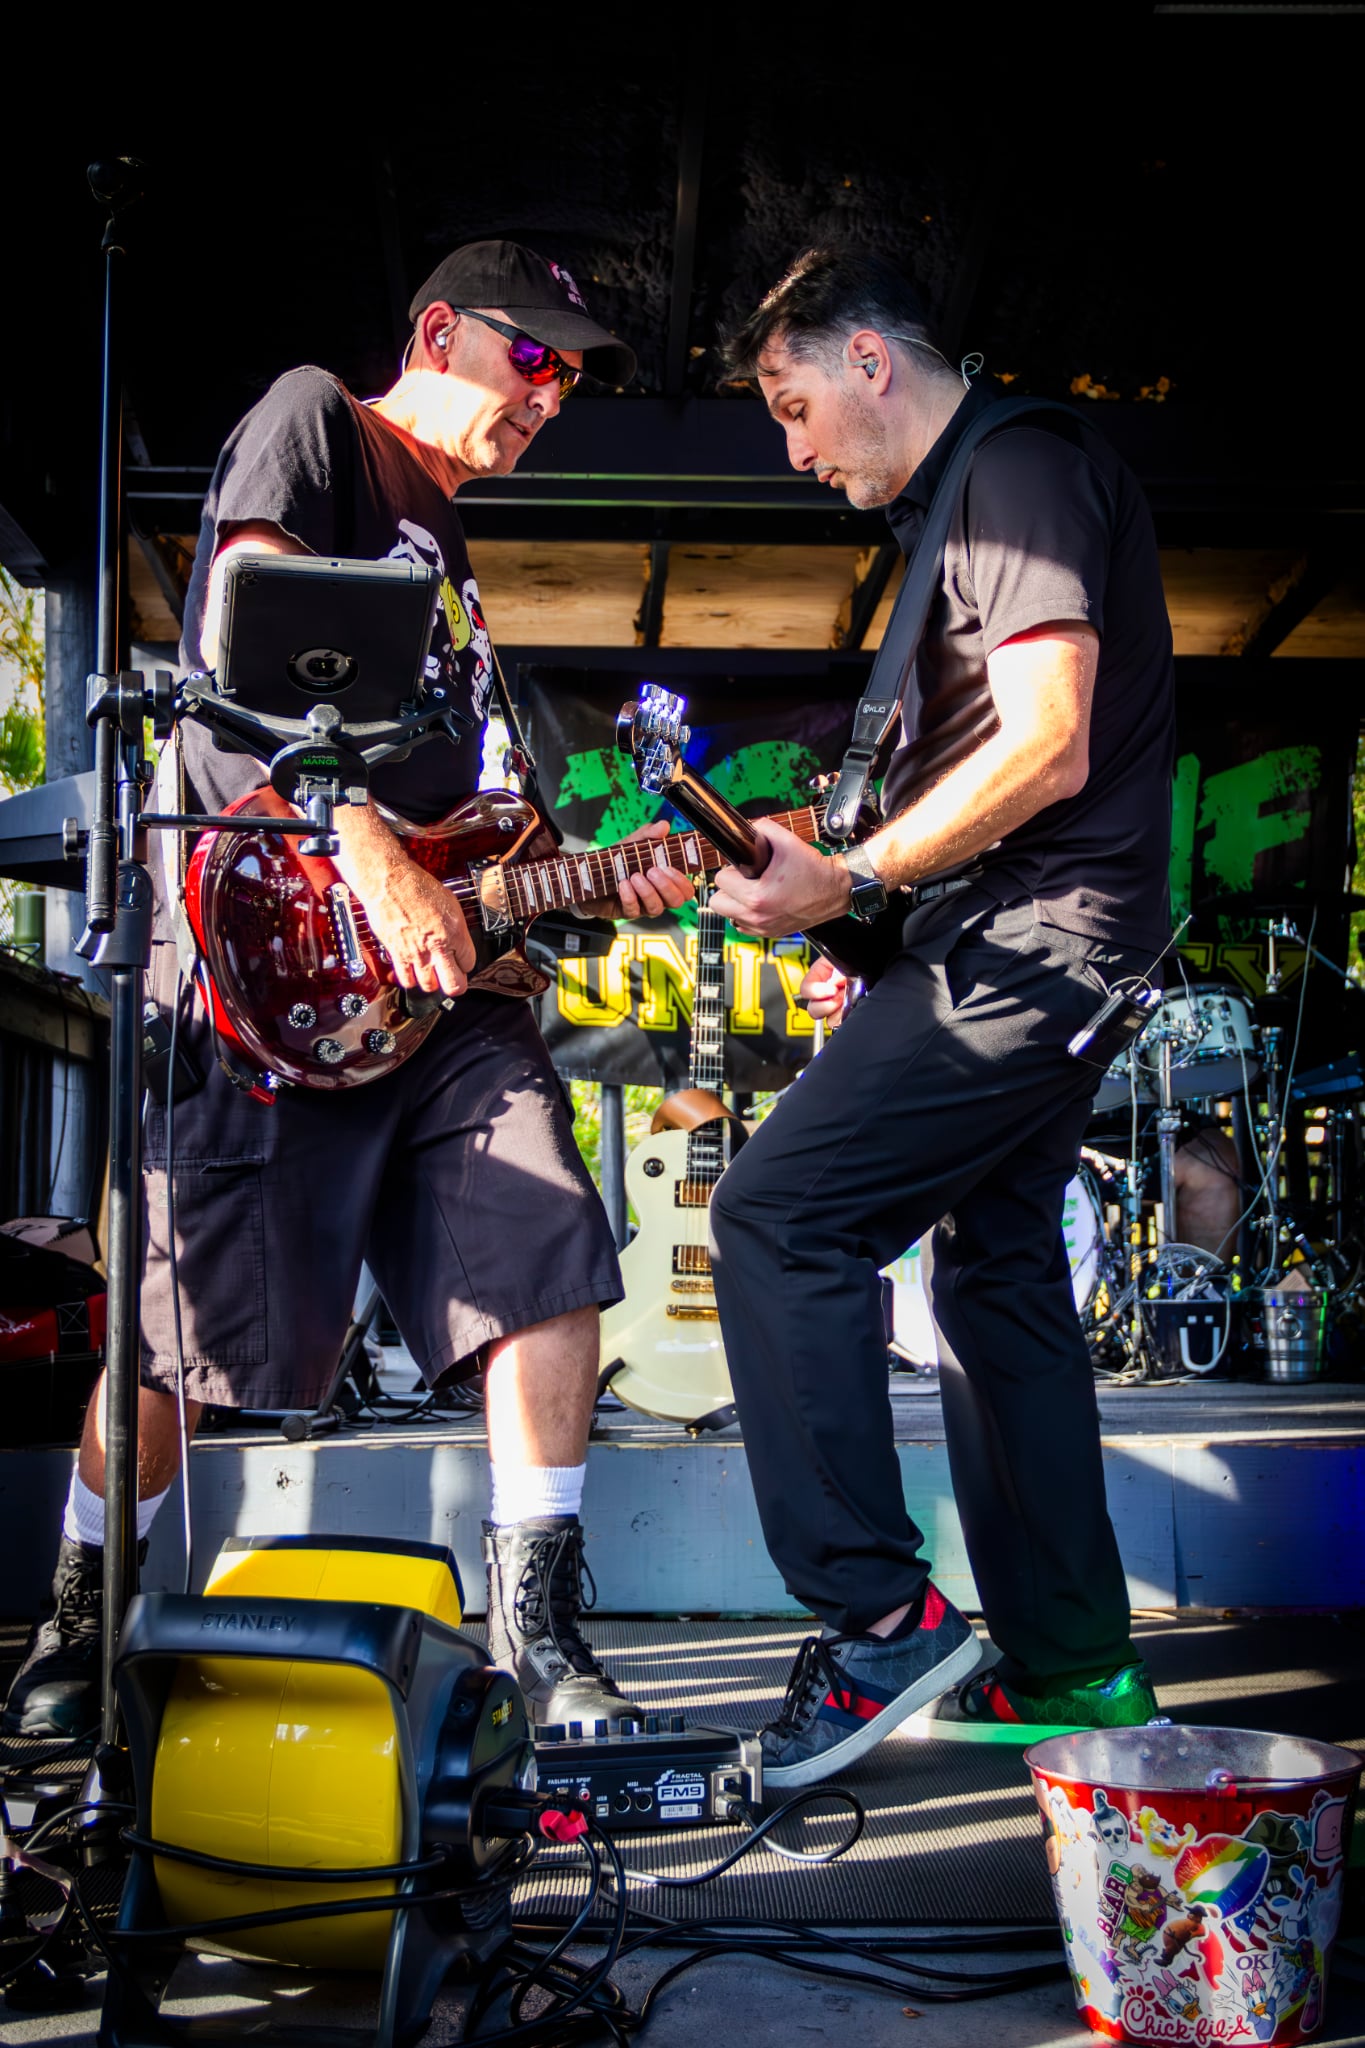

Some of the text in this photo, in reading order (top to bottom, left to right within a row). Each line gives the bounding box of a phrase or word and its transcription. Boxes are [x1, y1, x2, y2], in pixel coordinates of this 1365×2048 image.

[303, 758, 339, 766] MANOS
[200, 1612, 297, 1632] STANLEY
[671, 1772, 703, 1780] FRACTAL
[661, 1786, 701, 1799] FM9
[1235, 1951, 1277, 1971] OK!
[1123, 1995, 1253, 2046] Chick-fil-A
